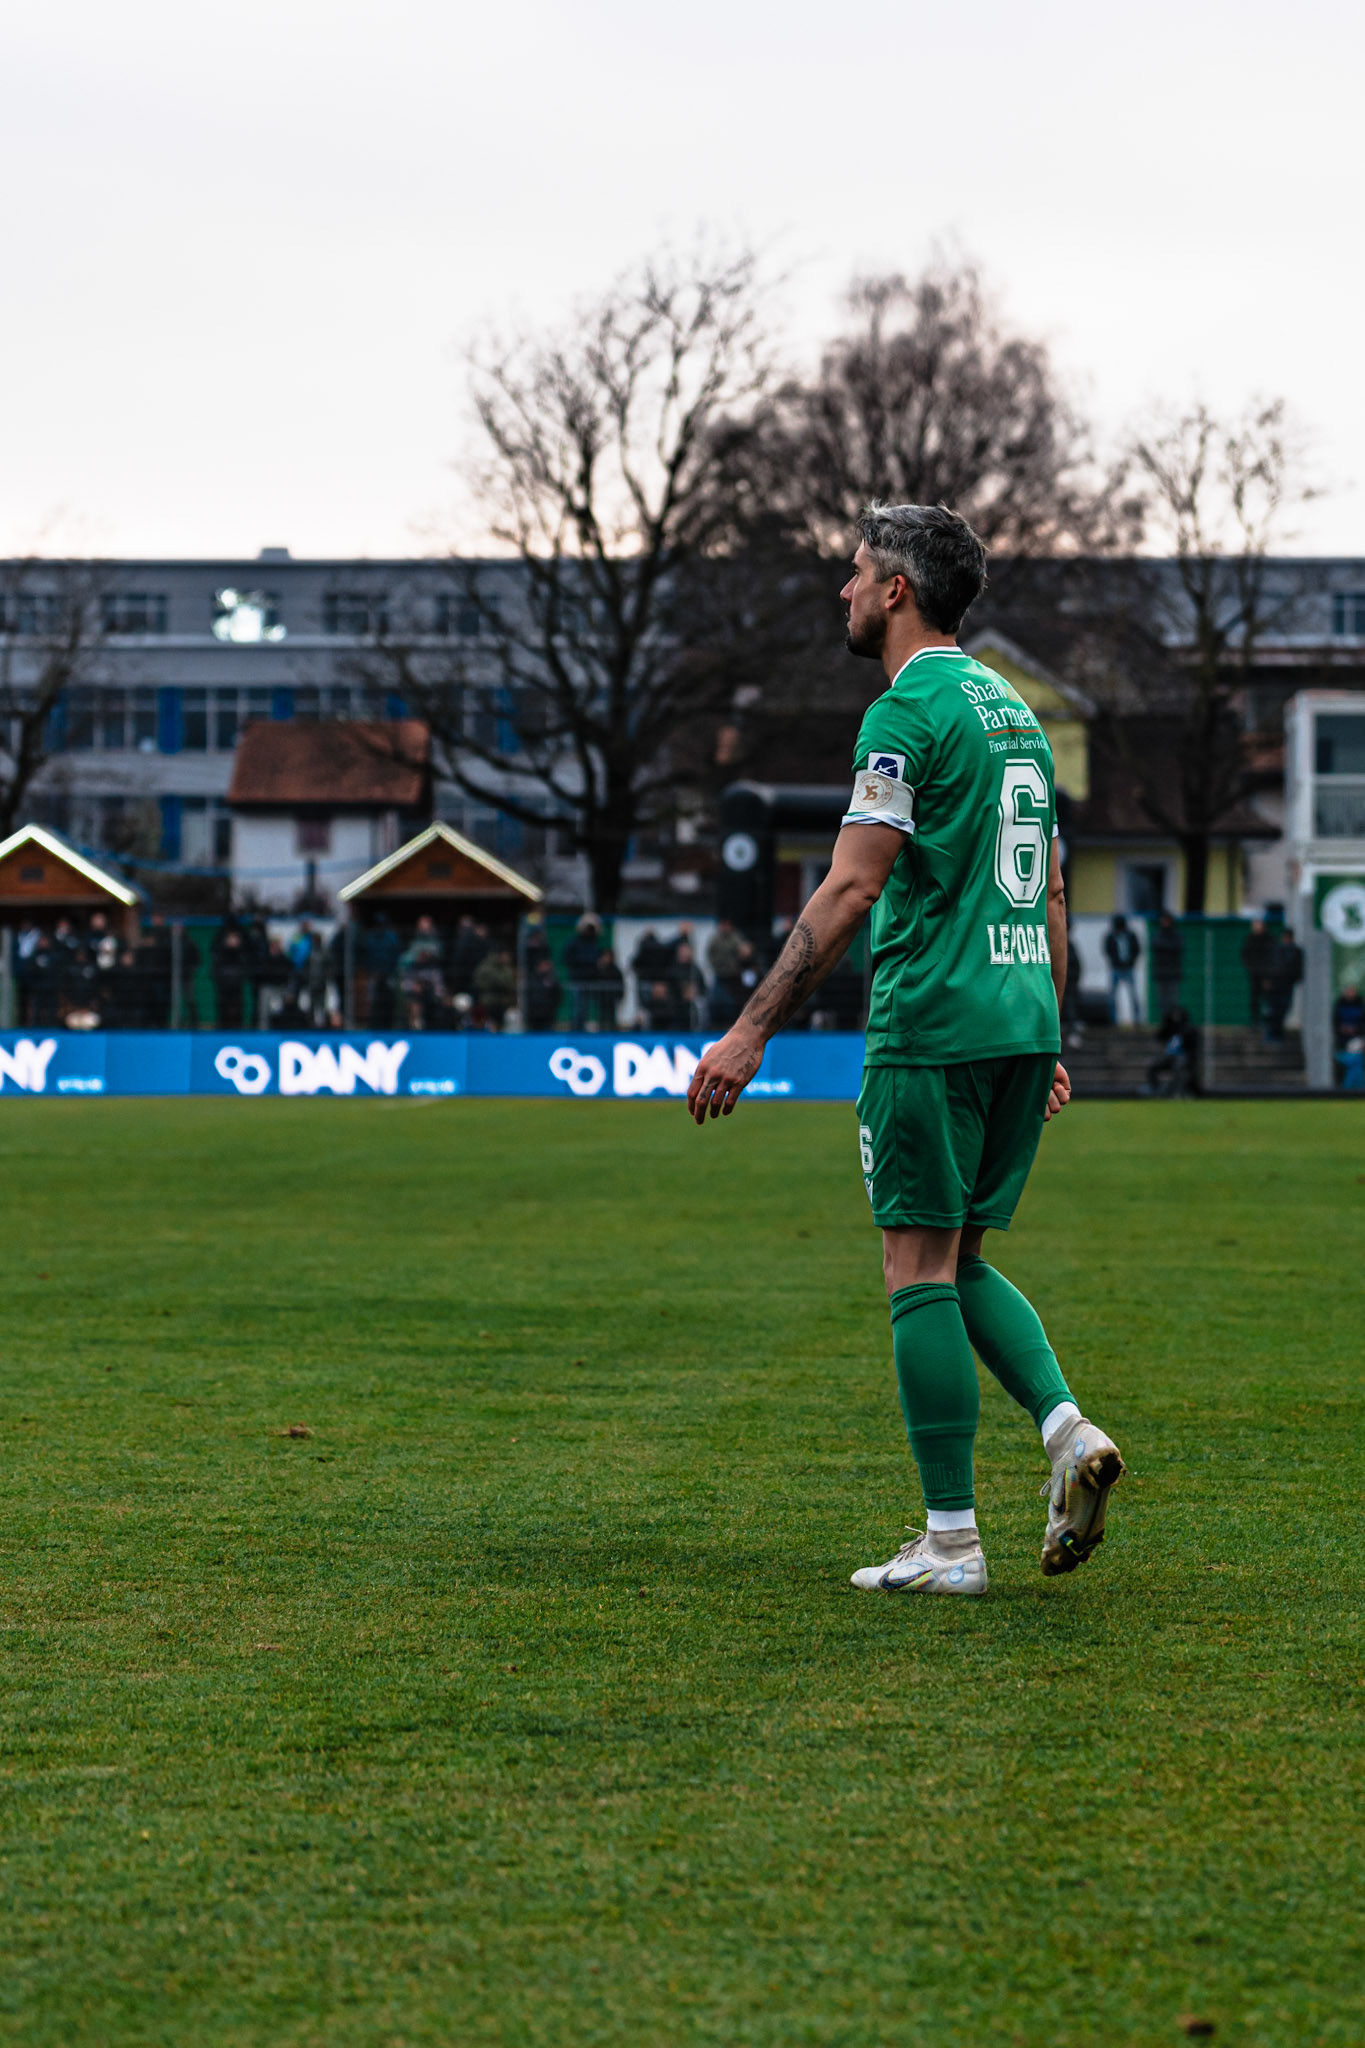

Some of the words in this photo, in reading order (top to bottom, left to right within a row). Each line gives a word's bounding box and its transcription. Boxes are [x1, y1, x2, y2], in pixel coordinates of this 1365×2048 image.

[1020, 737, 1049, 751] Servic
[995, 758, 1049, 908] 6
[278, 1039, 410, 1095] DANY
[612, 1041, 719, 1096] DAN
[859, 1125, 875, 1173] 6
